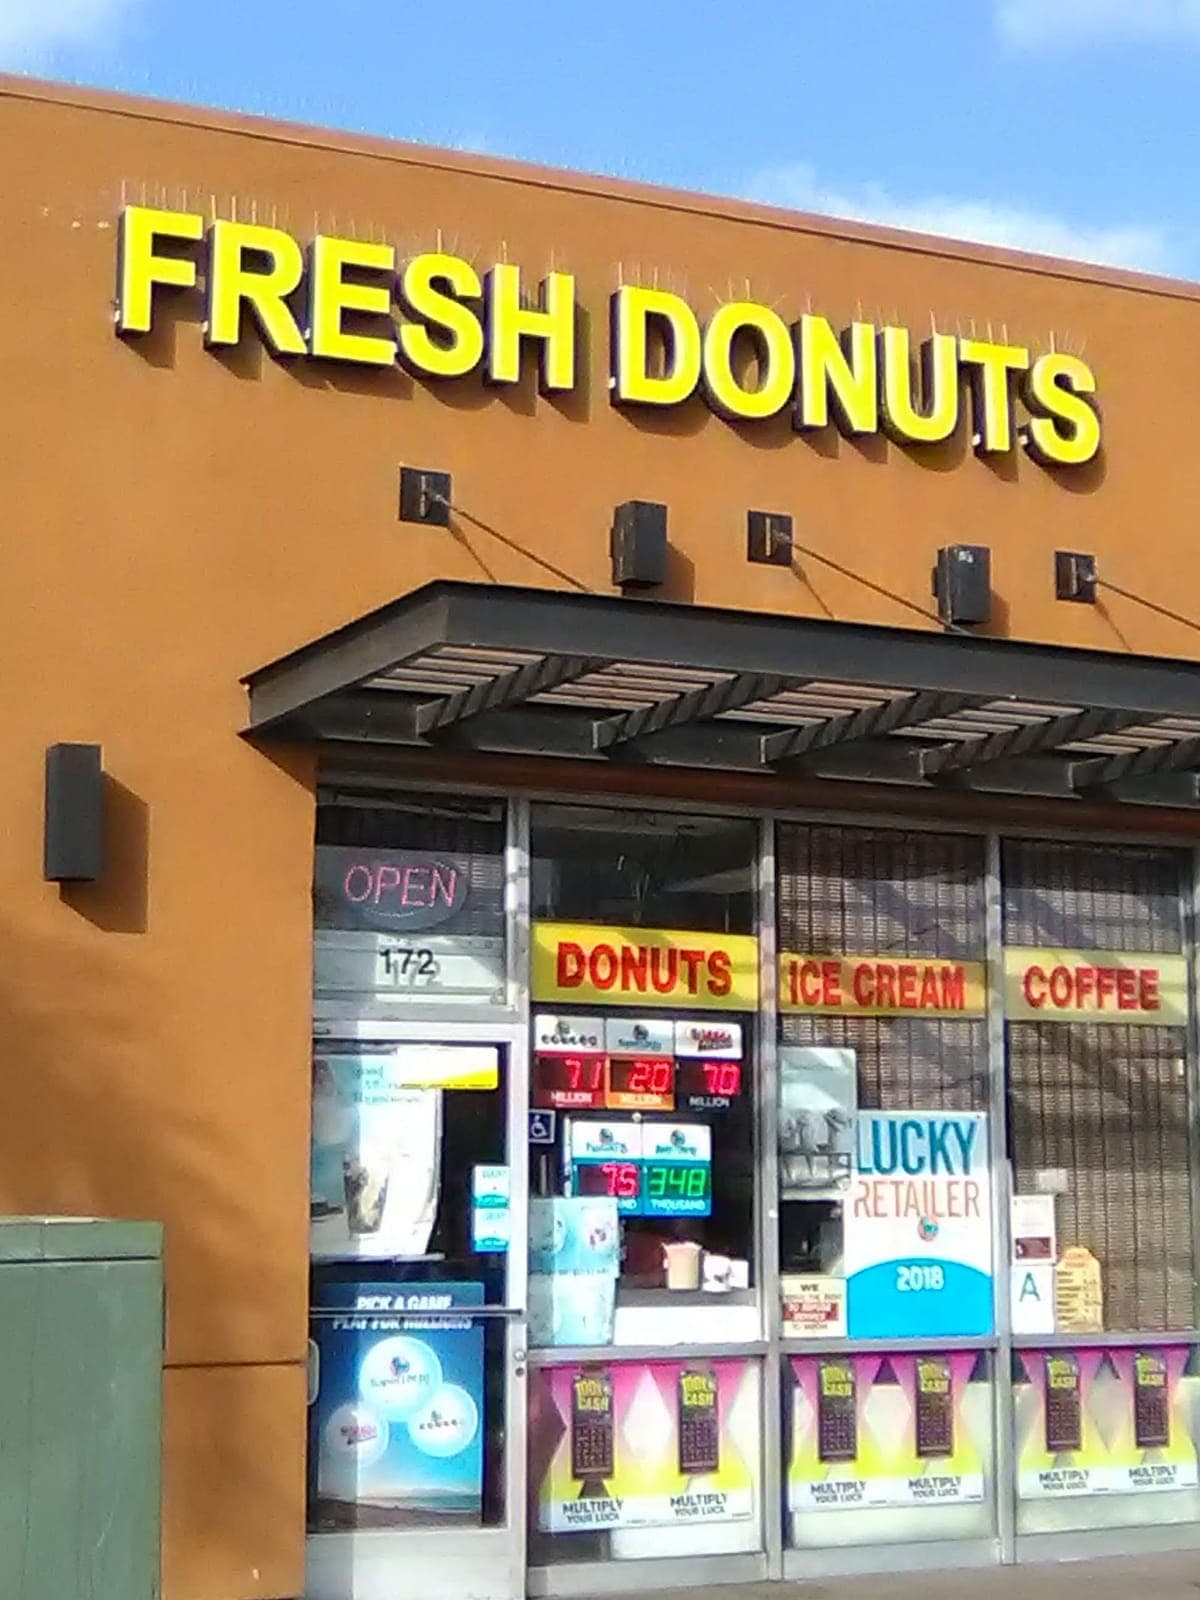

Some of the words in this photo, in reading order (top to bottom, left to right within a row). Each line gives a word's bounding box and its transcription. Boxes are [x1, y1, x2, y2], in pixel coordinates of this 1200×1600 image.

[117, 206, 577, 391] FRESH
[612, 286, 1103, 465] DONUTS
[343, 864, 458, 908] OPEN
[379, 948, 437, 976] 172
[556, 941, 732, 997] DONUTS
[789, 959, 842, 1006] ICE
[853, 961, 966, 1011] CREAM
[1023, 965, 1161, 1012] COFFEE
[564, 1058, 602, 1090] 71
[629, 1061, 671, 1093] 20
[703, 1063, 741, 1096] 70
[857, 1119, 978, 1176] LUCKY
[601, 1162, 640, 1197] 75
[650, 1167, 707, 1197] 348
[651, 1199, 706, 1211] THOUSAND
[853, 1180, 981, 1218] RETAILER
[896, 1265, 944, 1292] 2018
[1019, 1272, 1041, 1302] A
[810, 1480, 866, 1494] MULTIPLY
[909, 1476, 961, 1490] MULTIPLY
[1039, 1469, 1089, 1482] MULTIPLY
[1129, 1465, 1177, 1478] MULTIPLY
[563, 1499, 624, 1515] MULTIPLY
[670, 1493, 728, 1508] MULTIPLY
